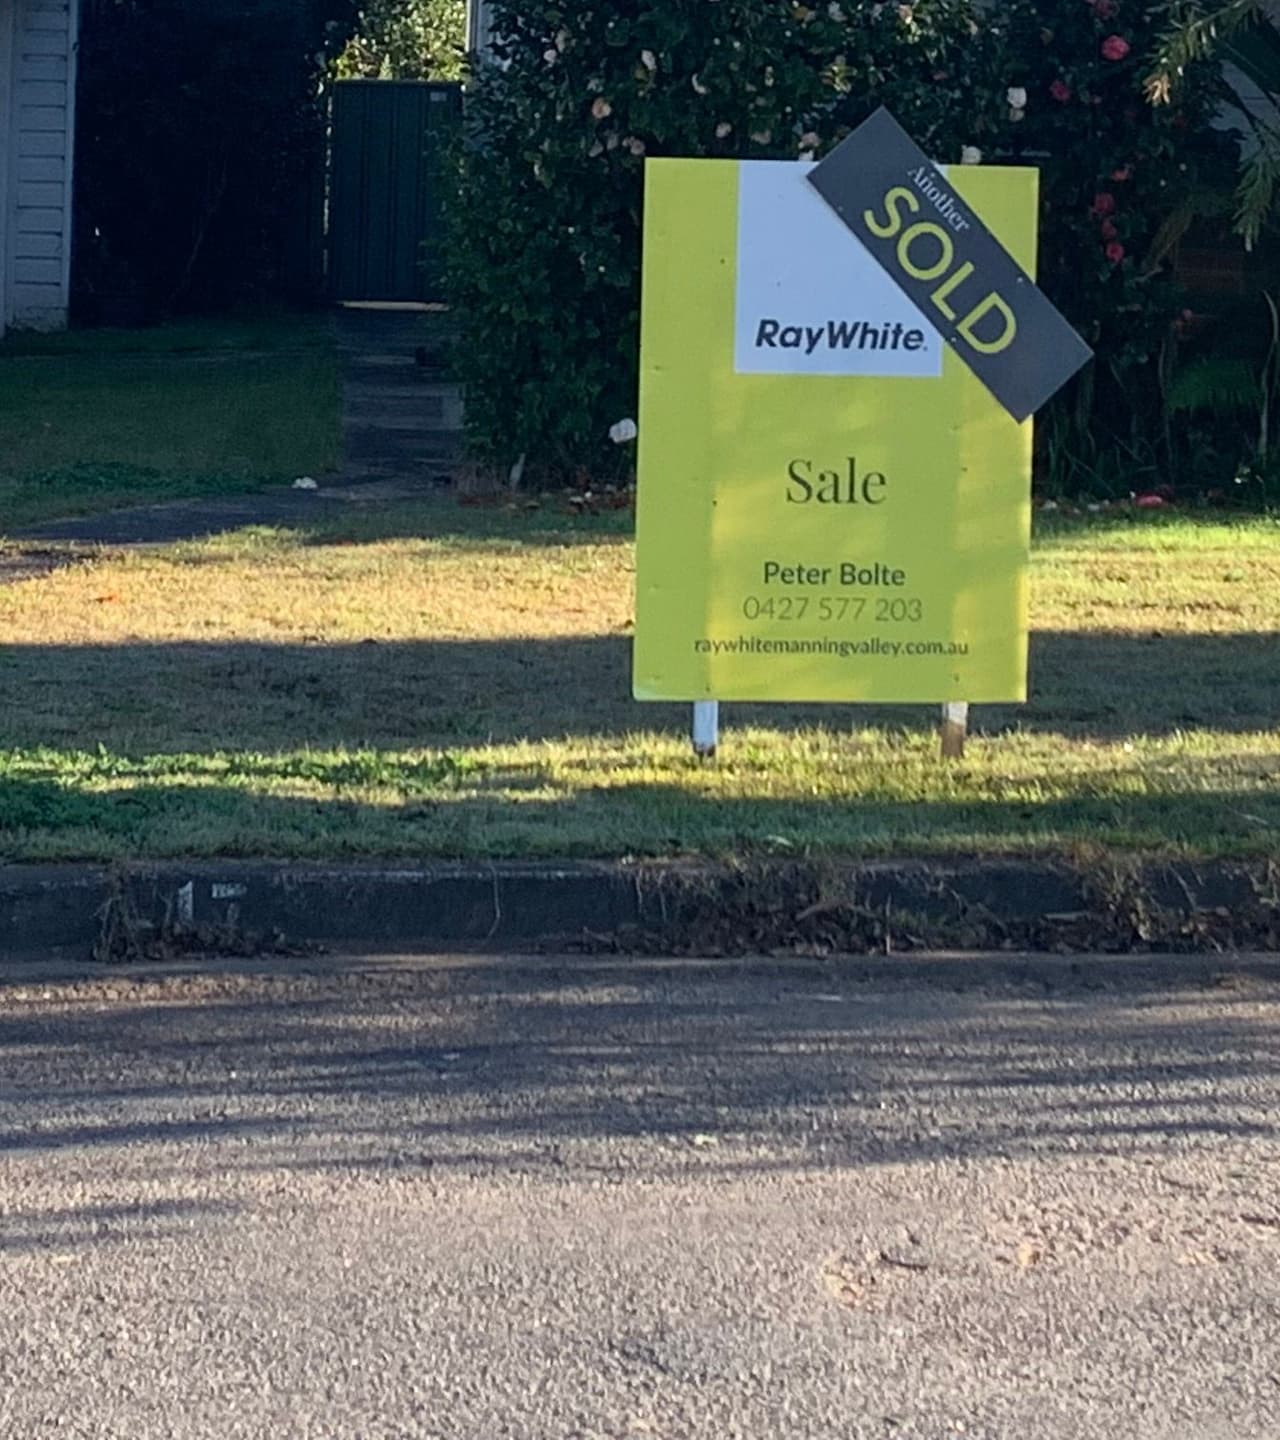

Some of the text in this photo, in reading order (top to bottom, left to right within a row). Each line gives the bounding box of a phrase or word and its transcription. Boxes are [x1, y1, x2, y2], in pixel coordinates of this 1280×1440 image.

[907, 165, 970, 233] Another
[863, 186, 1017, 354] SOLD
[785, 456, 888, 505] Sale
[763, 561, 906, 587] Peter Bolte
[742, 594, 923, 623] 0427 577 203
[694, 634, 969, 657] raywhitemanningvalley.com.au
